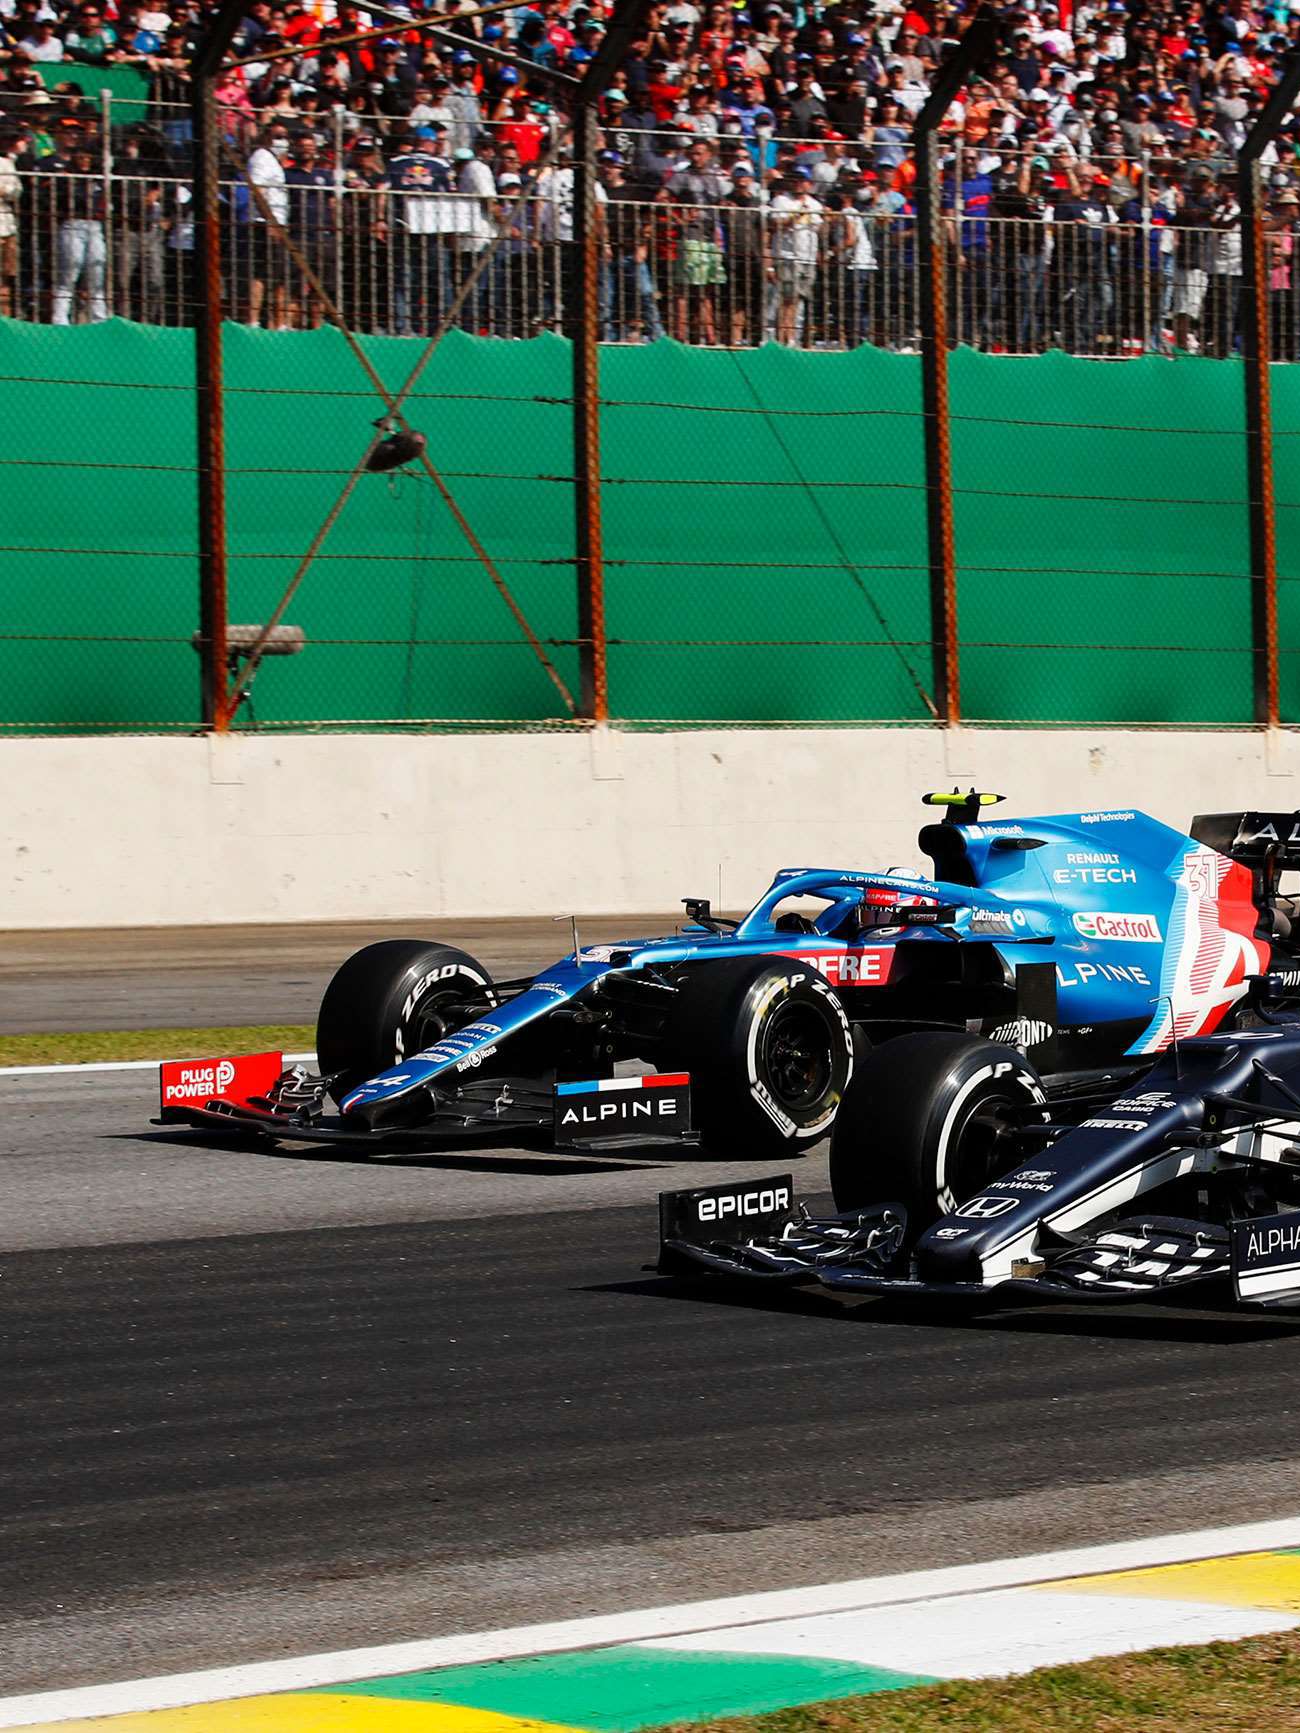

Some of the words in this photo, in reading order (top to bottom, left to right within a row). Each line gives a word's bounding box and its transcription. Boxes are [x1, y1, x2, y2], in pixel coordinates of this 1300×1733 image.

[1066, 853, 1120, 865] RENAULT
[1184, 853, 1217, 899] 31
[1096, 916, 1157, 938] Castrol
[1056, 963, 1151, 987] LPINE
[402, 964, 460, 1022] ZERO
[789, 973, 806, 988] P
[811, 979, 854, 1057] ZERO
[181, 1067, 215, 1084] PLUG
[993, 1062, 1014, 1078] P
[166, 1082, 215, 1100] POWER
[561, 1099, 677, 1125] ALPINE
